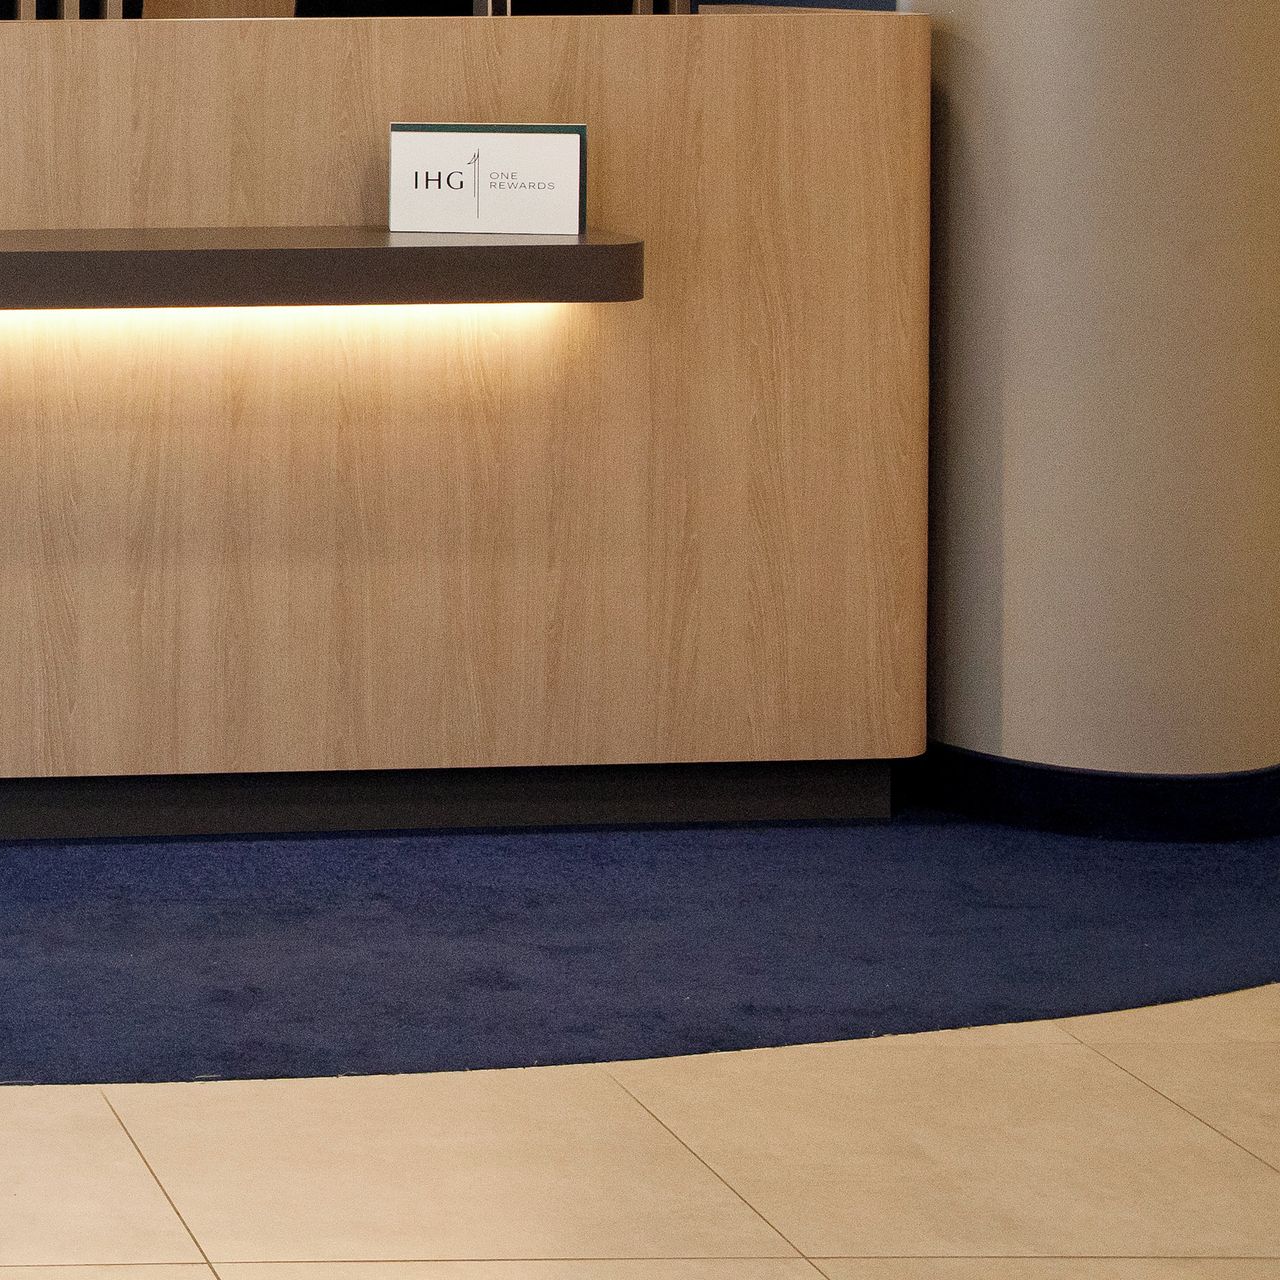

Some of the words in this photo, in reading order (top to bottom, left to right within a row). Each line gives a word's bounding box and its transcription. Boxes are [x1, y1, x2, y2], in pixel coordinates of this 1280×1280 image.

[413, 170, 464, 190] IHG
[489, 171, 518, 180] ONE
[489, 181, 555, 190] REWARDS
